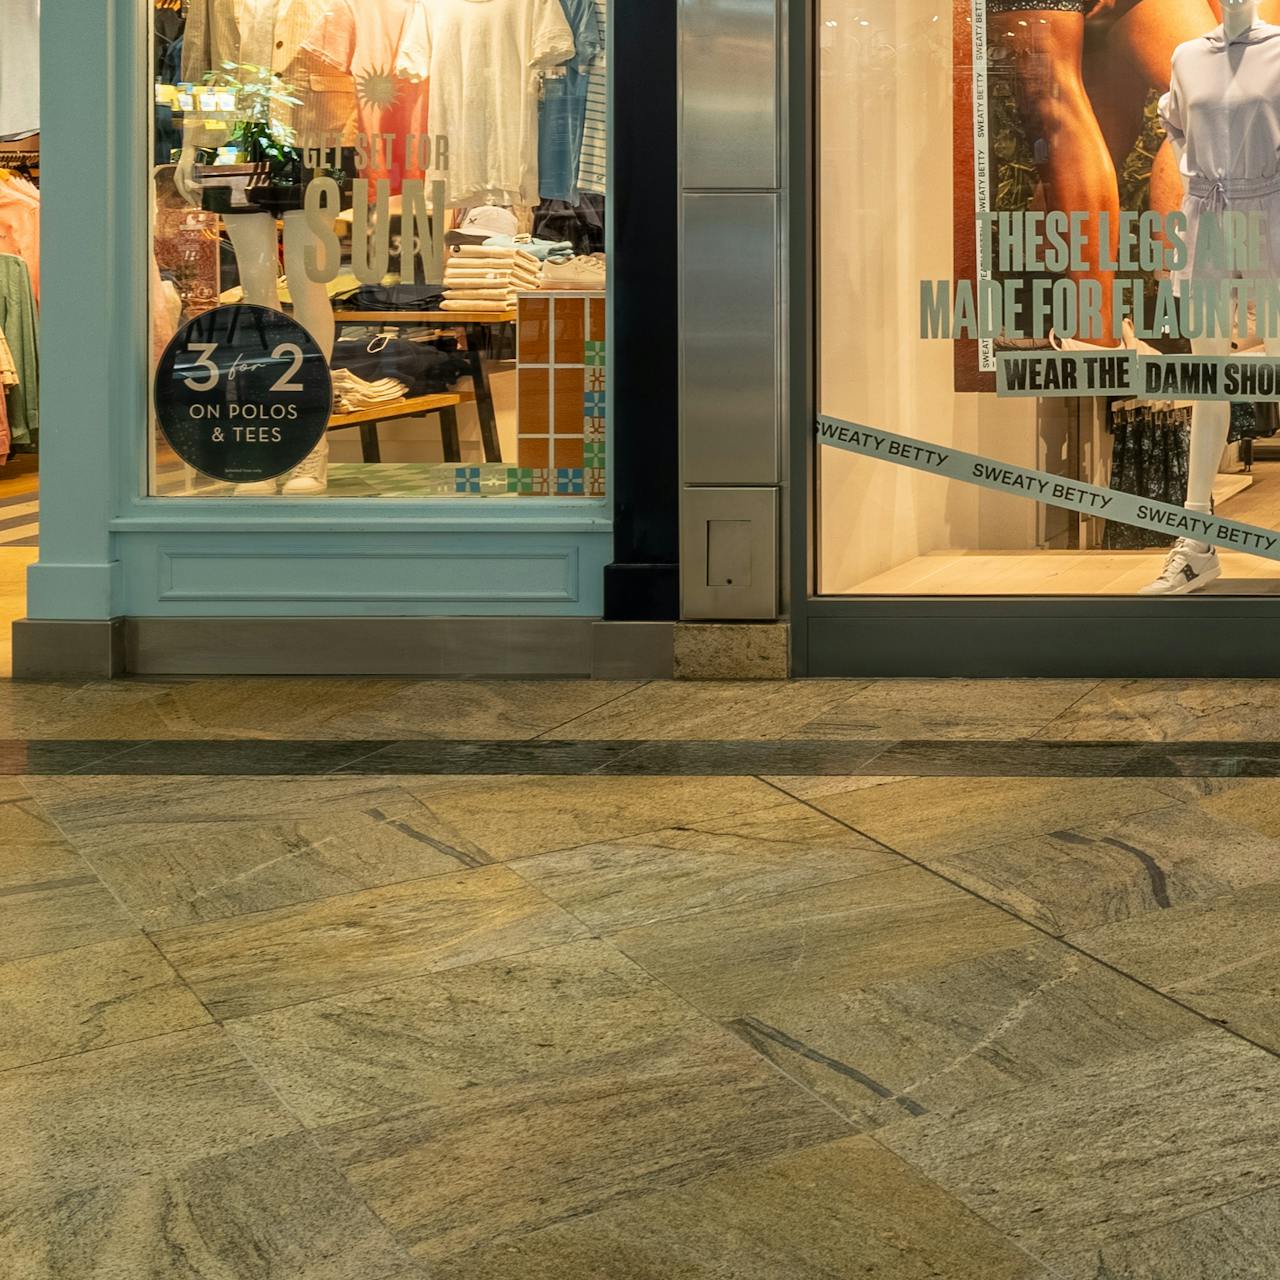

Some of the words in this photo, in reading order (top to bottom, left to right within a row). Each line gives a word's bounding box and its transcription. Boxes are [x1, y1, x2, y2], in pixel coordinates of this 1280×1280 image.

[975, 24, 983, 61] SWEATY
[976, 72, 984, 100] BETTY
[977, 102, 985, 138] SWEATY
[302, 132, 344, 170] GET
[354, 133, 396, 170] SET
[405, 134, 449, 171] FOR
[977, 150, 985, 177] BETTY
[303, 176, 446, 285] SUN
[976, 211, 1090, 272] THESE
[1100, 211, 1188, 272] LEGS
[1192, 210, 1267, 271] ARE
[920, 279, 1025, 339] MADE
[1032, 278, 1102, 339] FOR
[183, 342, 220, 392] 3
[228, 353, 266, 381] for
[269, 342, 304, 392] 2
[1004, 357, 1078, 391] WEAR
[1083, 356, 1130, 389] THE
[1145, 362, 1217, 394] DAMN
[189, 404, 220, 419] ON
[229, 404, 298, 420] POLOS
[211, 427, 225, 442] &
[232, 427, 282, 442] TEES
[888, 440, 949, 467] BETTY
[972, 463, 1050, 494] SWEATY
[1051, 483, 1113, 509] BETTY
[1136, 505, 1214, 535] SWEATY
[1216, 524, 1278, 551] BETTY
